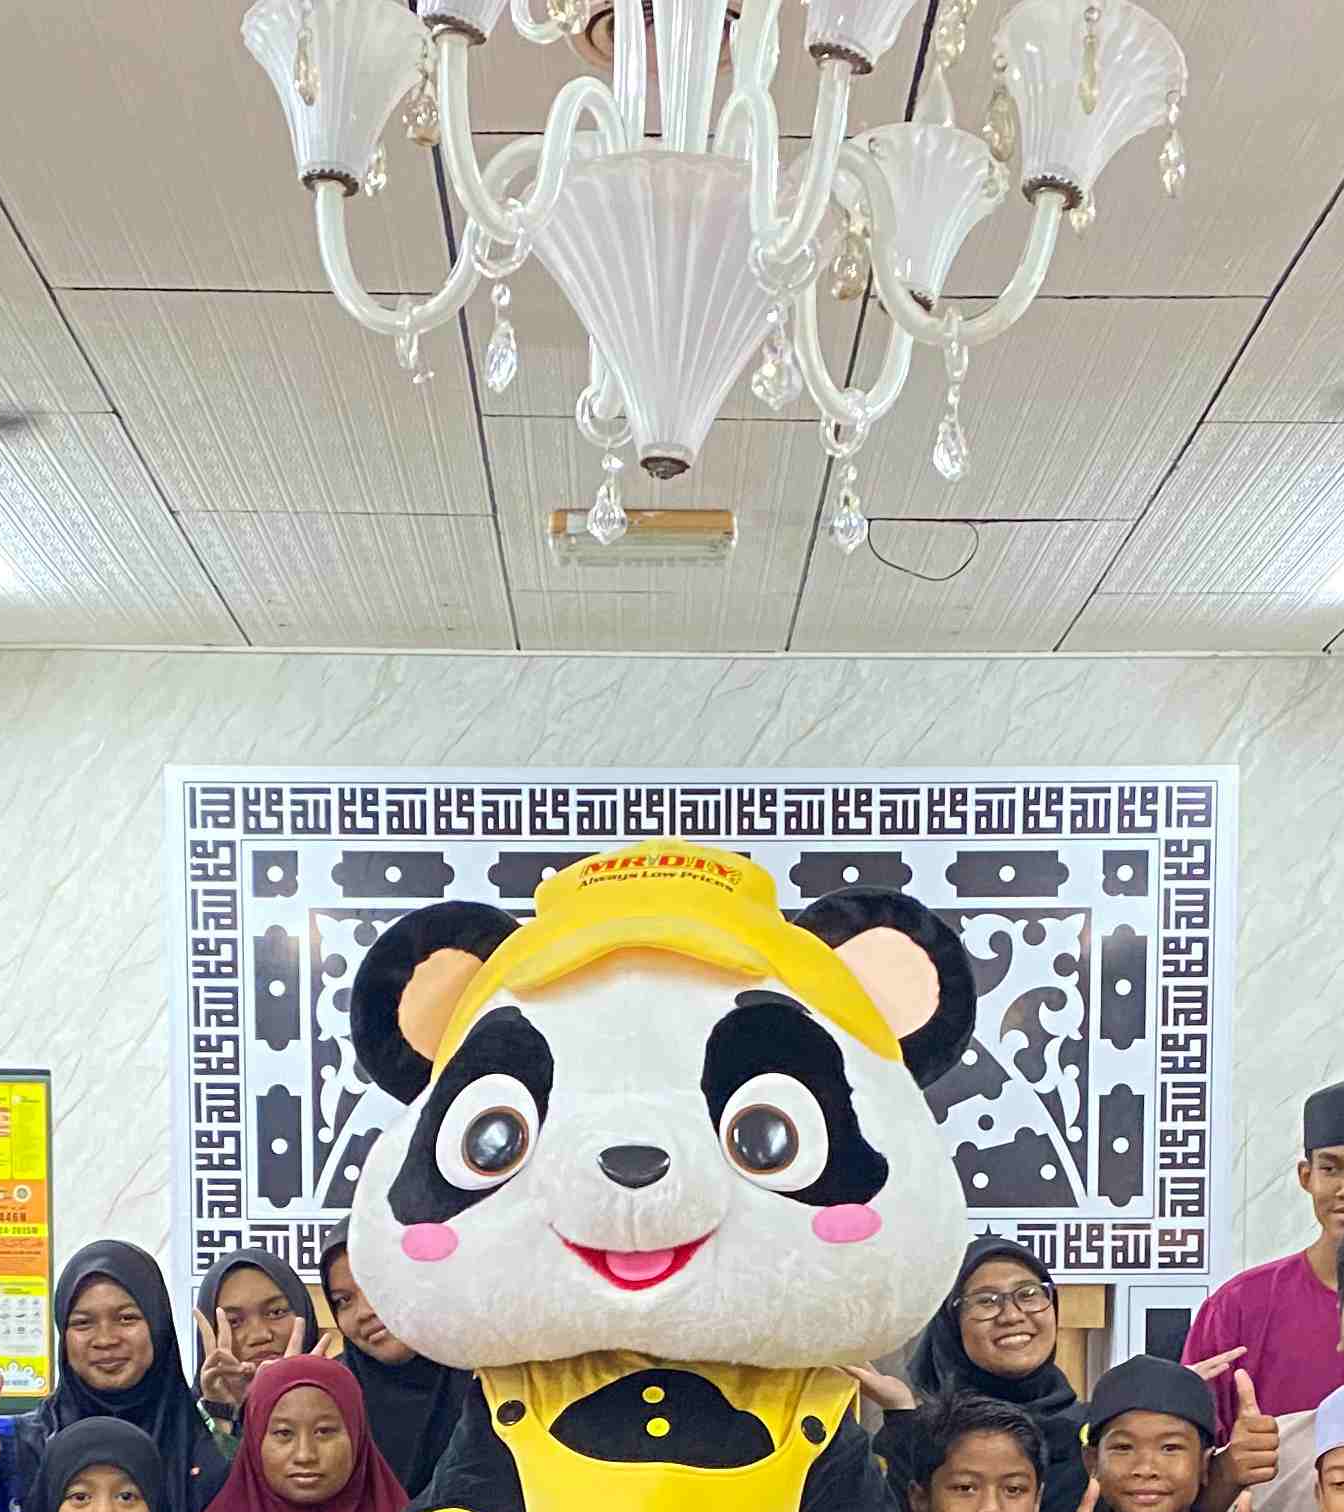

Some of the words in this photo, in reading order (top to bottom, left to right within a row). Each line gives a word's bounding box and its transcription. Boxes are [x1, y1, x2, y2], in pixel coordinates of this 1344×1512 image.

[577, 872, 637, 892] Always
[642, 870, 675, 879] Low
[680, 871, 734, 893] Prices
